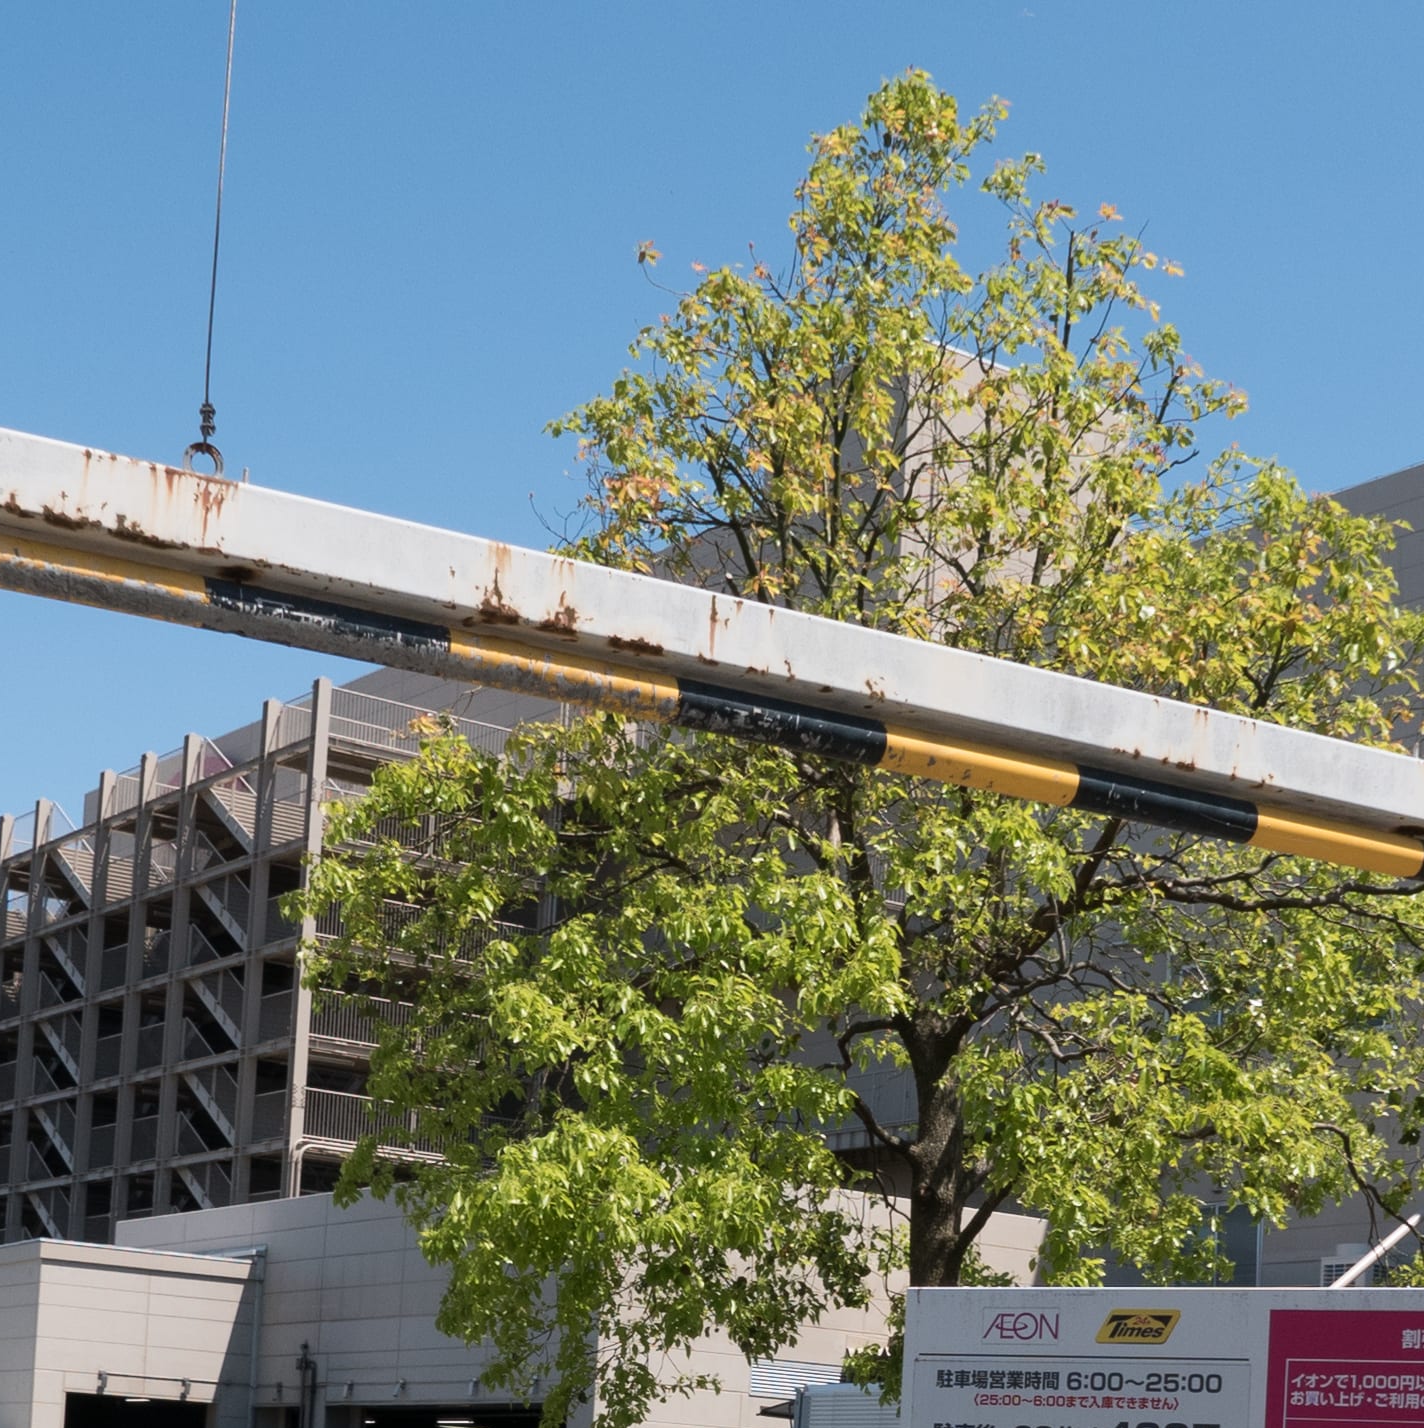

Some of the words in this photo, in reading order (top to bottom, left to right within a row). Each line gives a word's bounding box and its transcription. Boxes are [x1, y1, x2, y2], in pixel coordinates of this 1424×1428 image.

[1108, 1320, 1165, 1338] Times
[936, 1370, 1060, 1391] 駐車場営業時間
